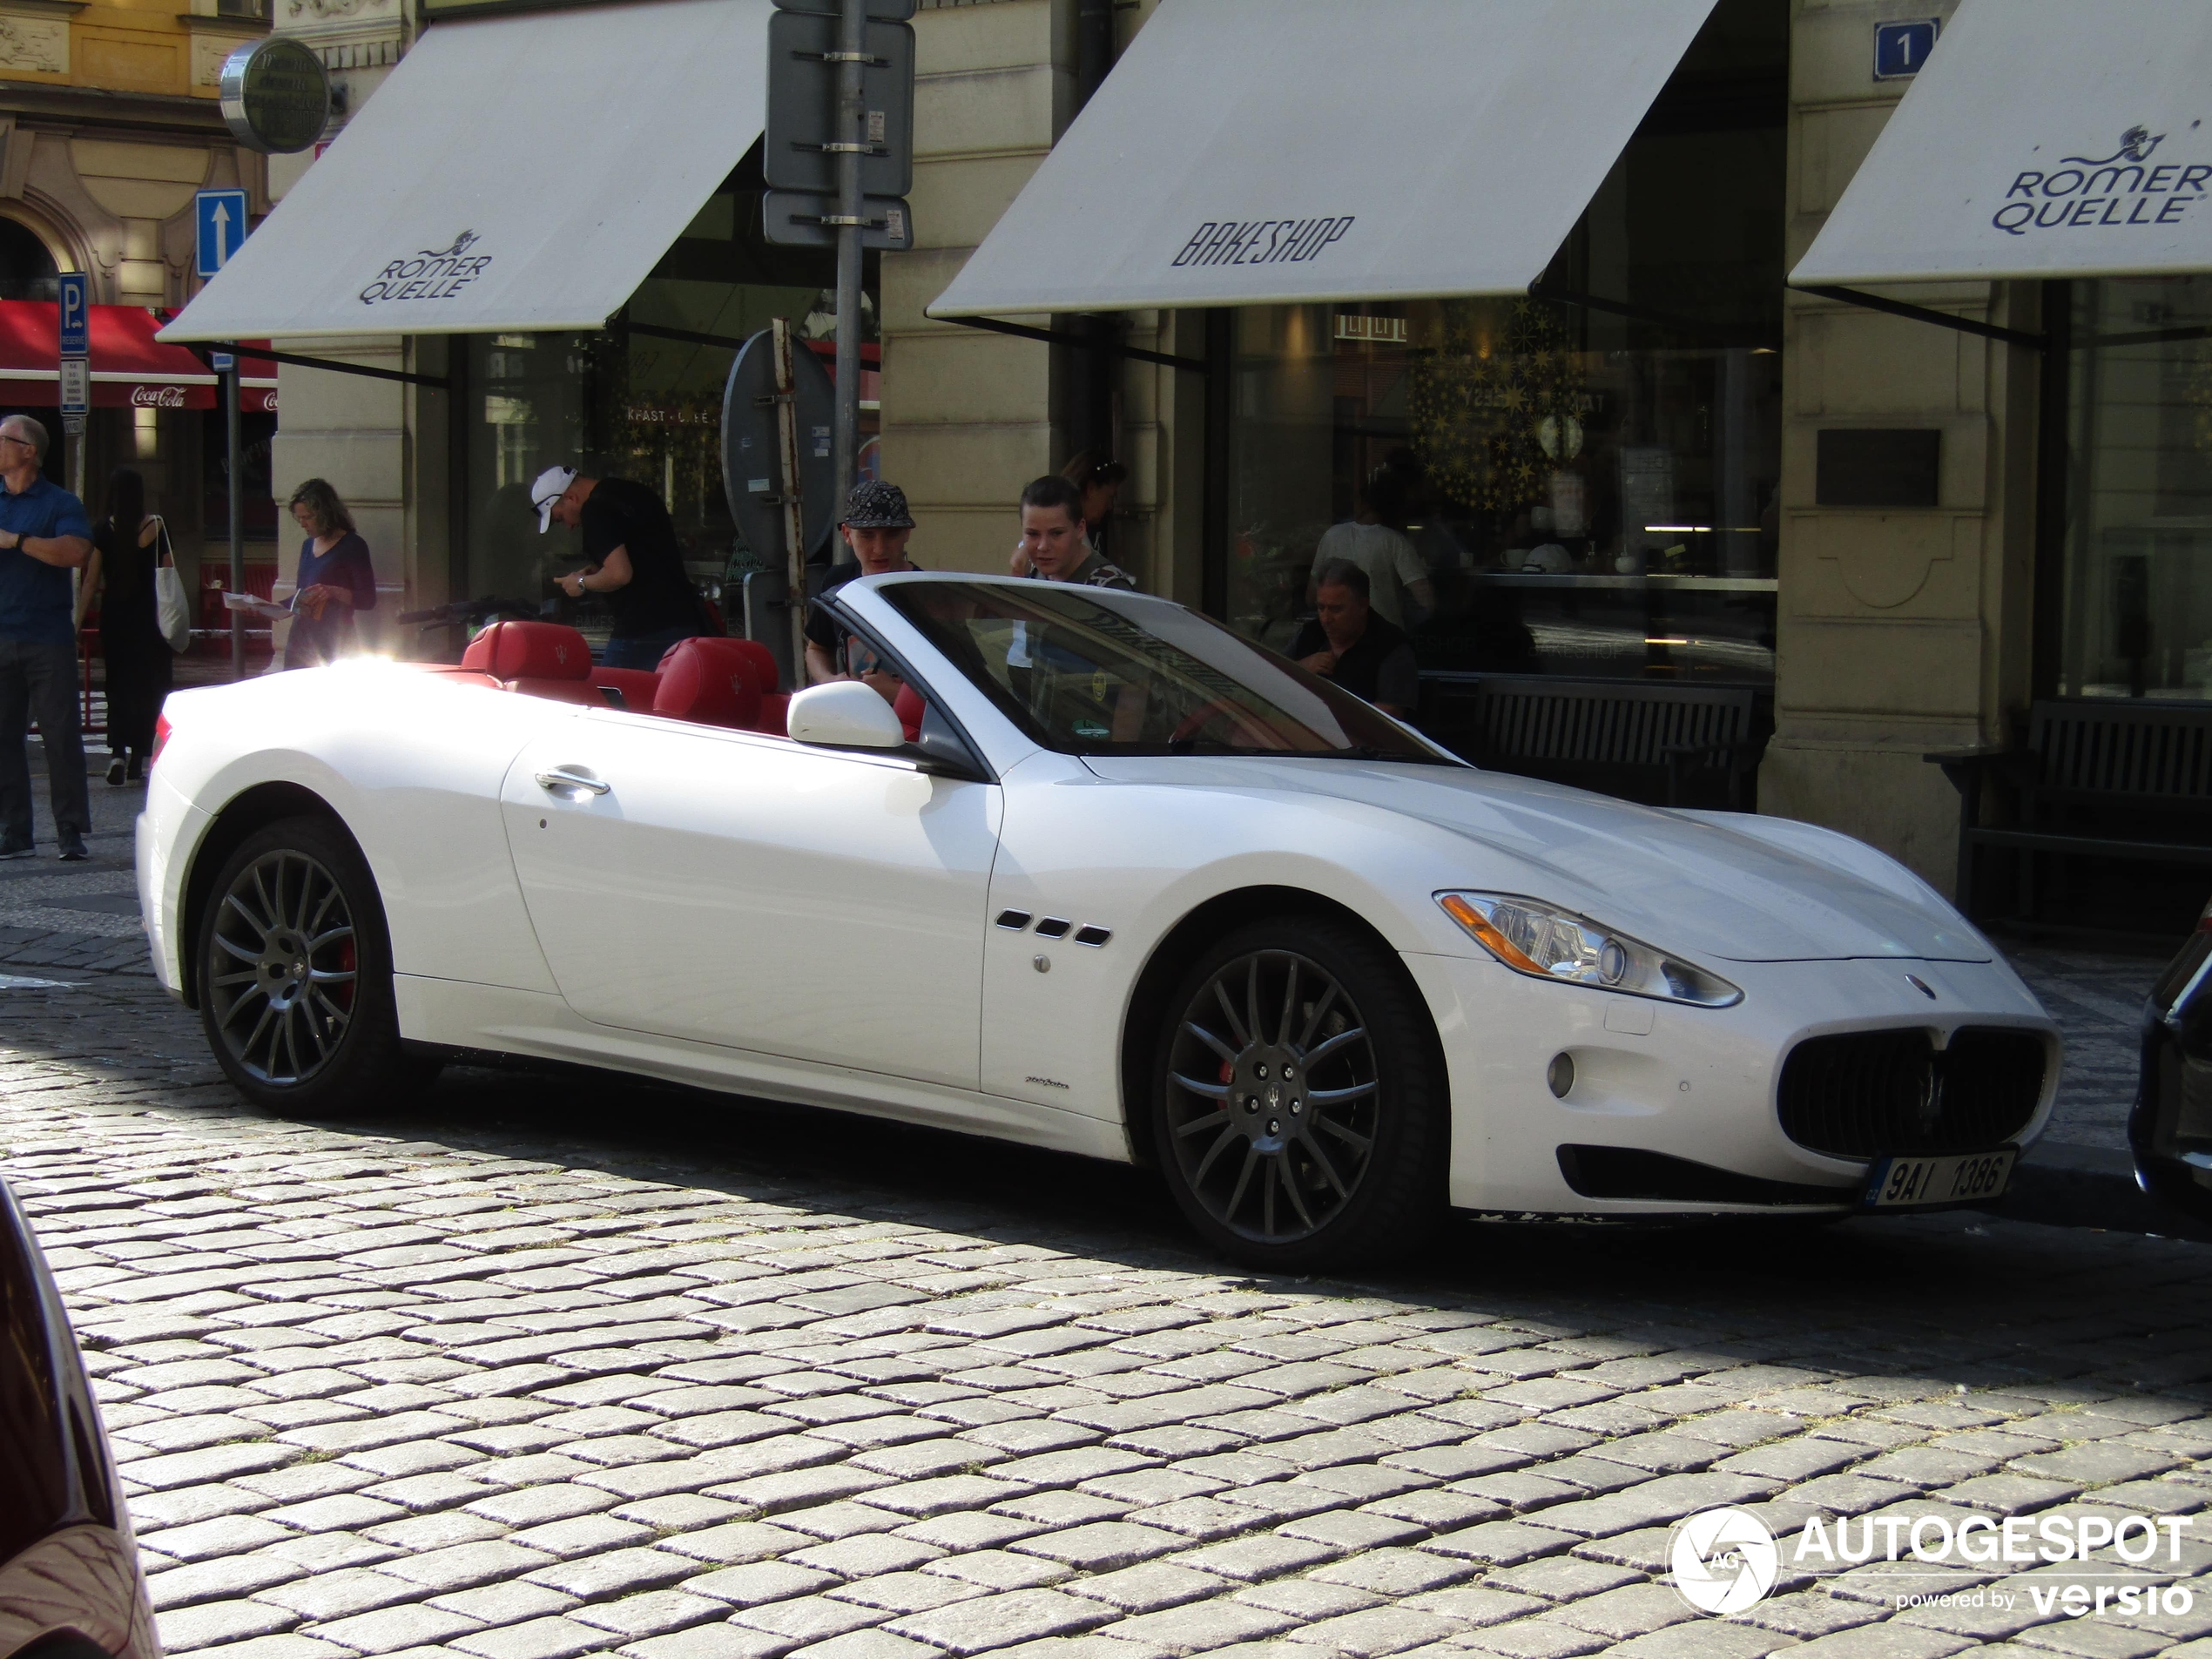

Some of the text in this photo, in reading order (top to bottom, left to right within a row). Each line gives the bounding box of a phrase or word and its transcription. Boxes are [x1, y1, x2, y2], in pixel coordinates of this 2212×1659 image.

[1896, 32, 1912, 66] 1
[1992, 197, 2195, 236] QUELLE
[1170, 215, 1356, 267] BAKESHOP
[359, 279, 473, 305] QUELLE
[131, 385, 188, 408] Coca-Cola
[1885, 1156, 2004, 1201] 9AI 1386
